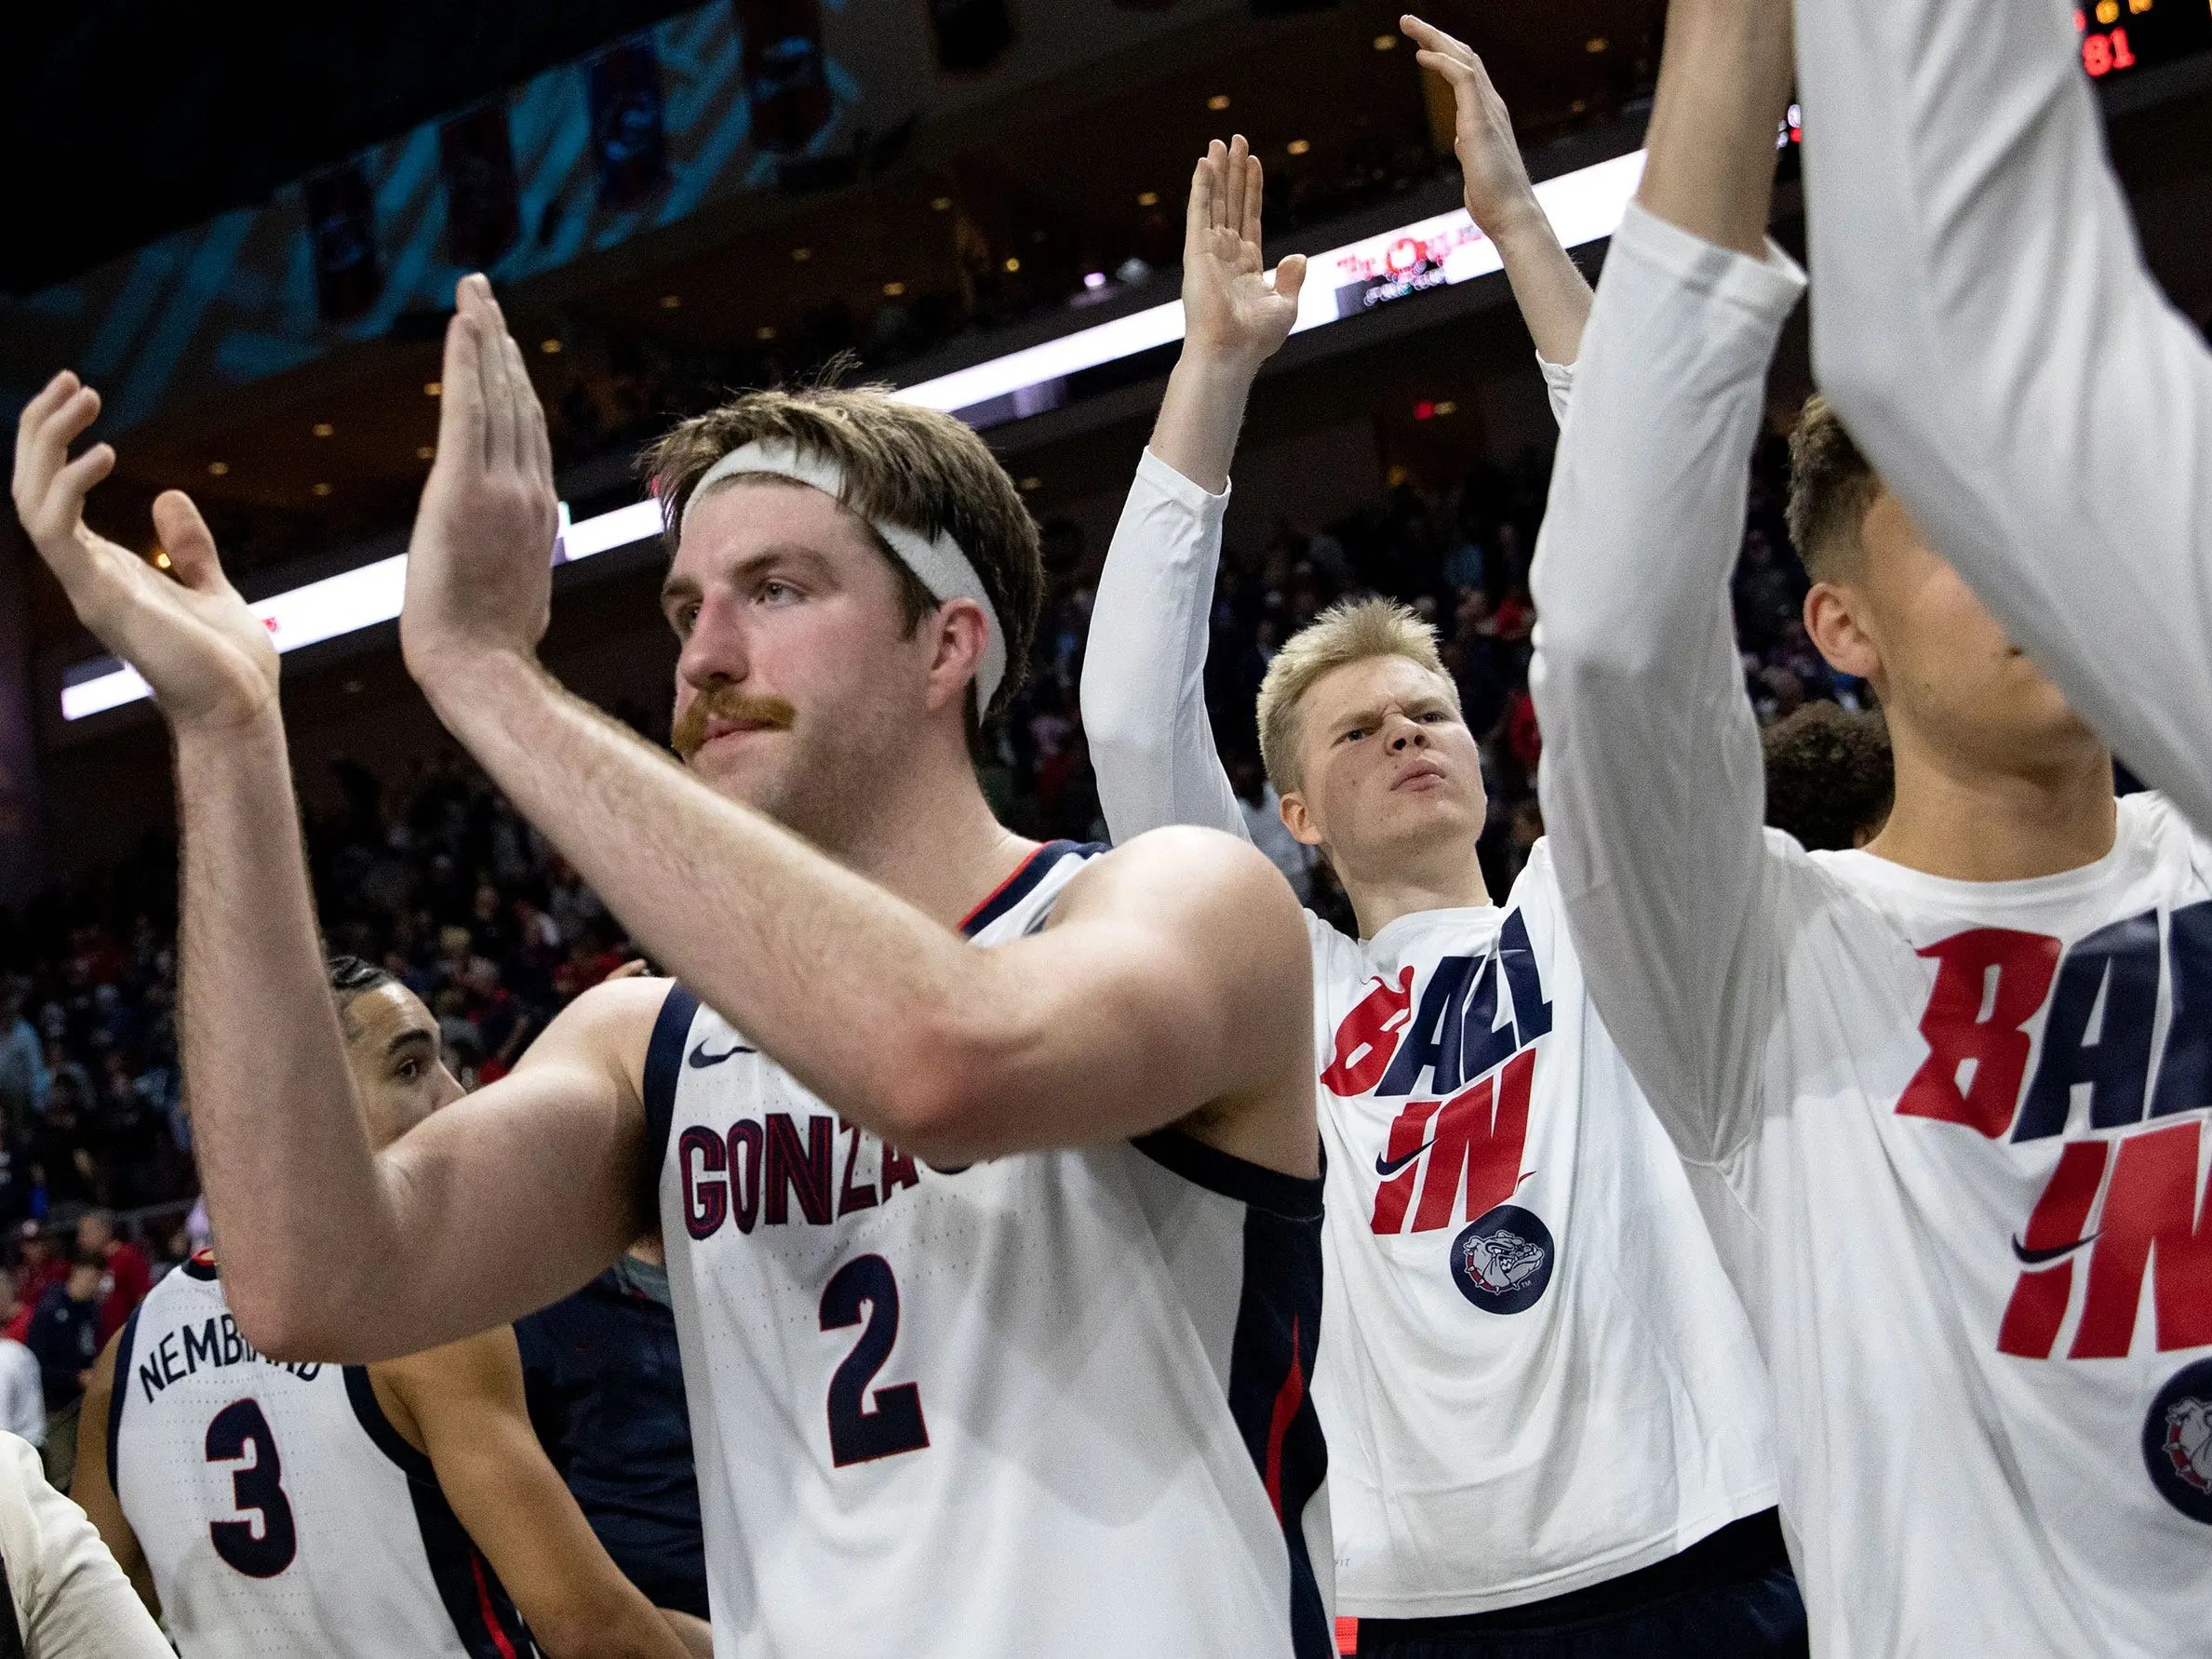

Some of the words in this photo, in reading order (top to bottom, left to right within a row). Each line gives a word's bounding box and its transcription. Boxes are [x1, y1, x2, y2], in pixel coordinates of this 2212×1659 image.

[2082, 27, 2136, 77] 81
[1320, 906, 1552, 1097] BALL
[678, 1112, 973, 1238] GONZA
[1372, 1048, 1536, 1236] IN
[140, 1314, 322, 1403] NEMB
[818, 1253, 931, 1468] 2
[205, 1398, 297, 1579] 3
